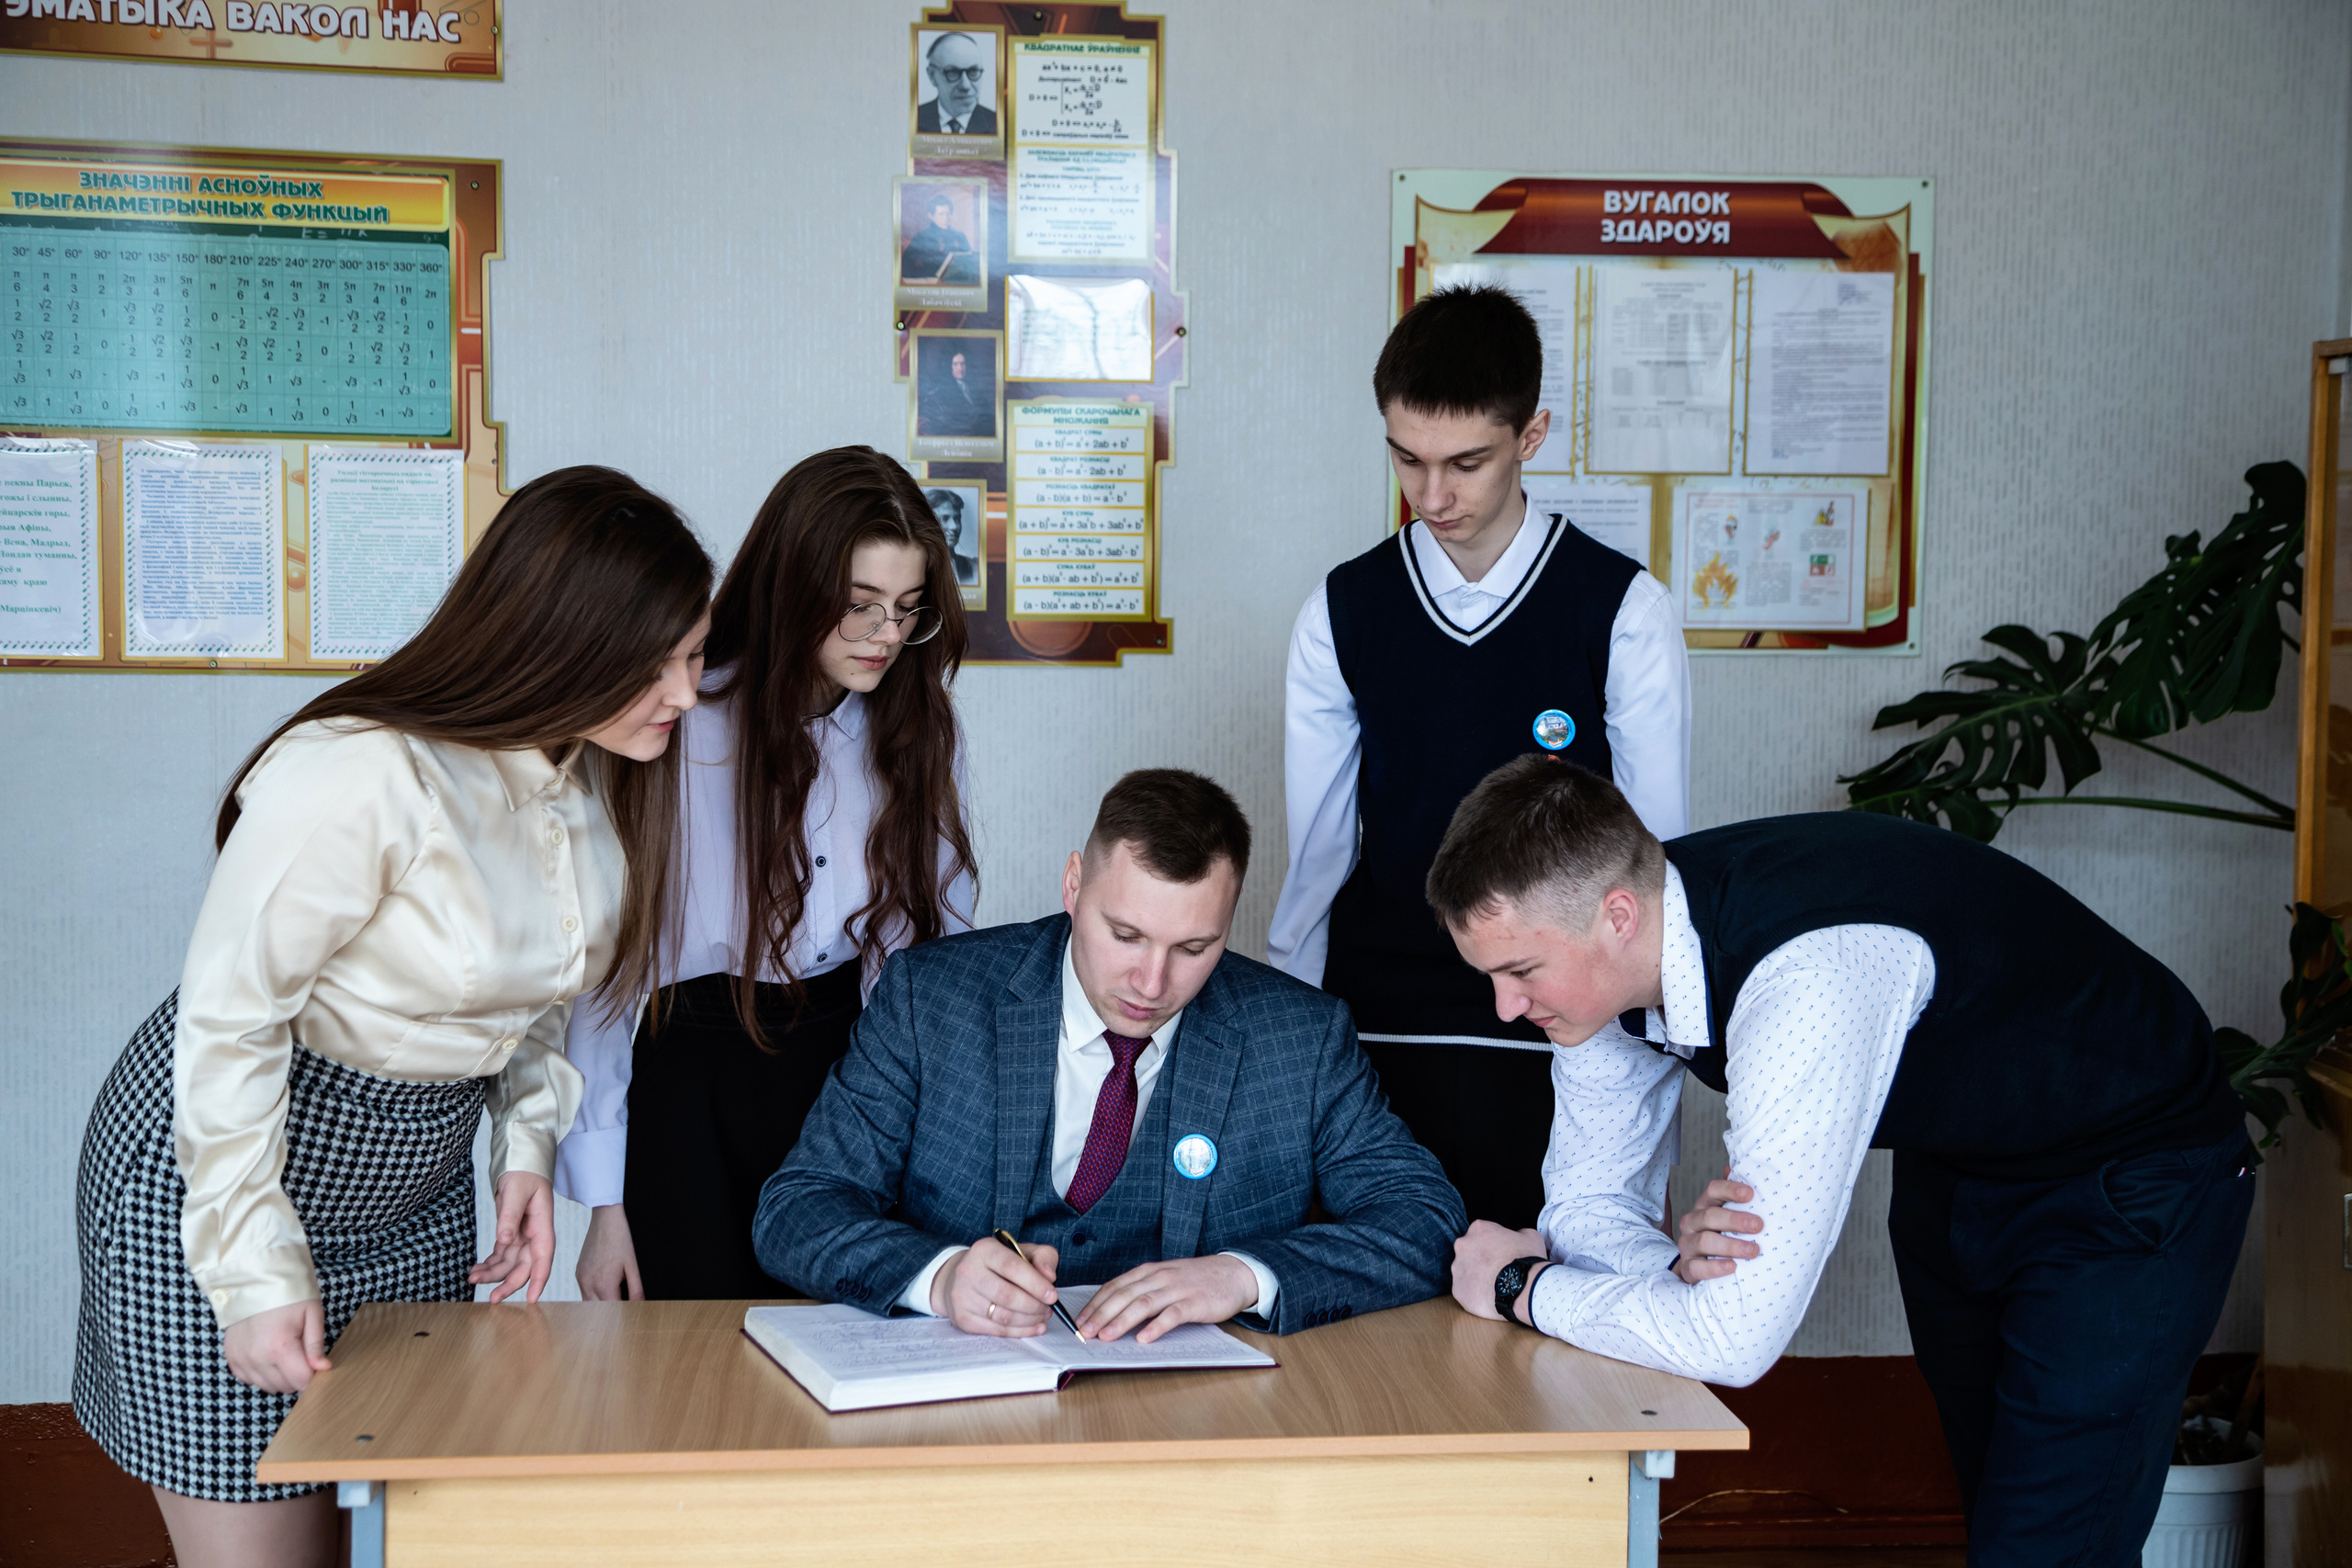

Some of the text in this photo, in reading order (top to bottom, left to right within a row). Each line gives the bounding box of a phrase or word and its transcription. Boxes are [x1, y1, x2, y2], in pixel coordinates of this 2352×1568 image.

[227, 1, 368, 38] ВАКОЛ
[382, 8, 460, 42] НАС
[79, 171, 323, 198] ЗНАЧЭННІ АСНОЎНЫХ
[11, 190, 390, 222] ТРЫГАНАМЕТРЫЧНЫХ ФУНКЦЫЙ
[1603, 189, 1731, 215] ВУГАЛОК
[1600, 218, 1731, 244] ЗДАРОЎЯ
